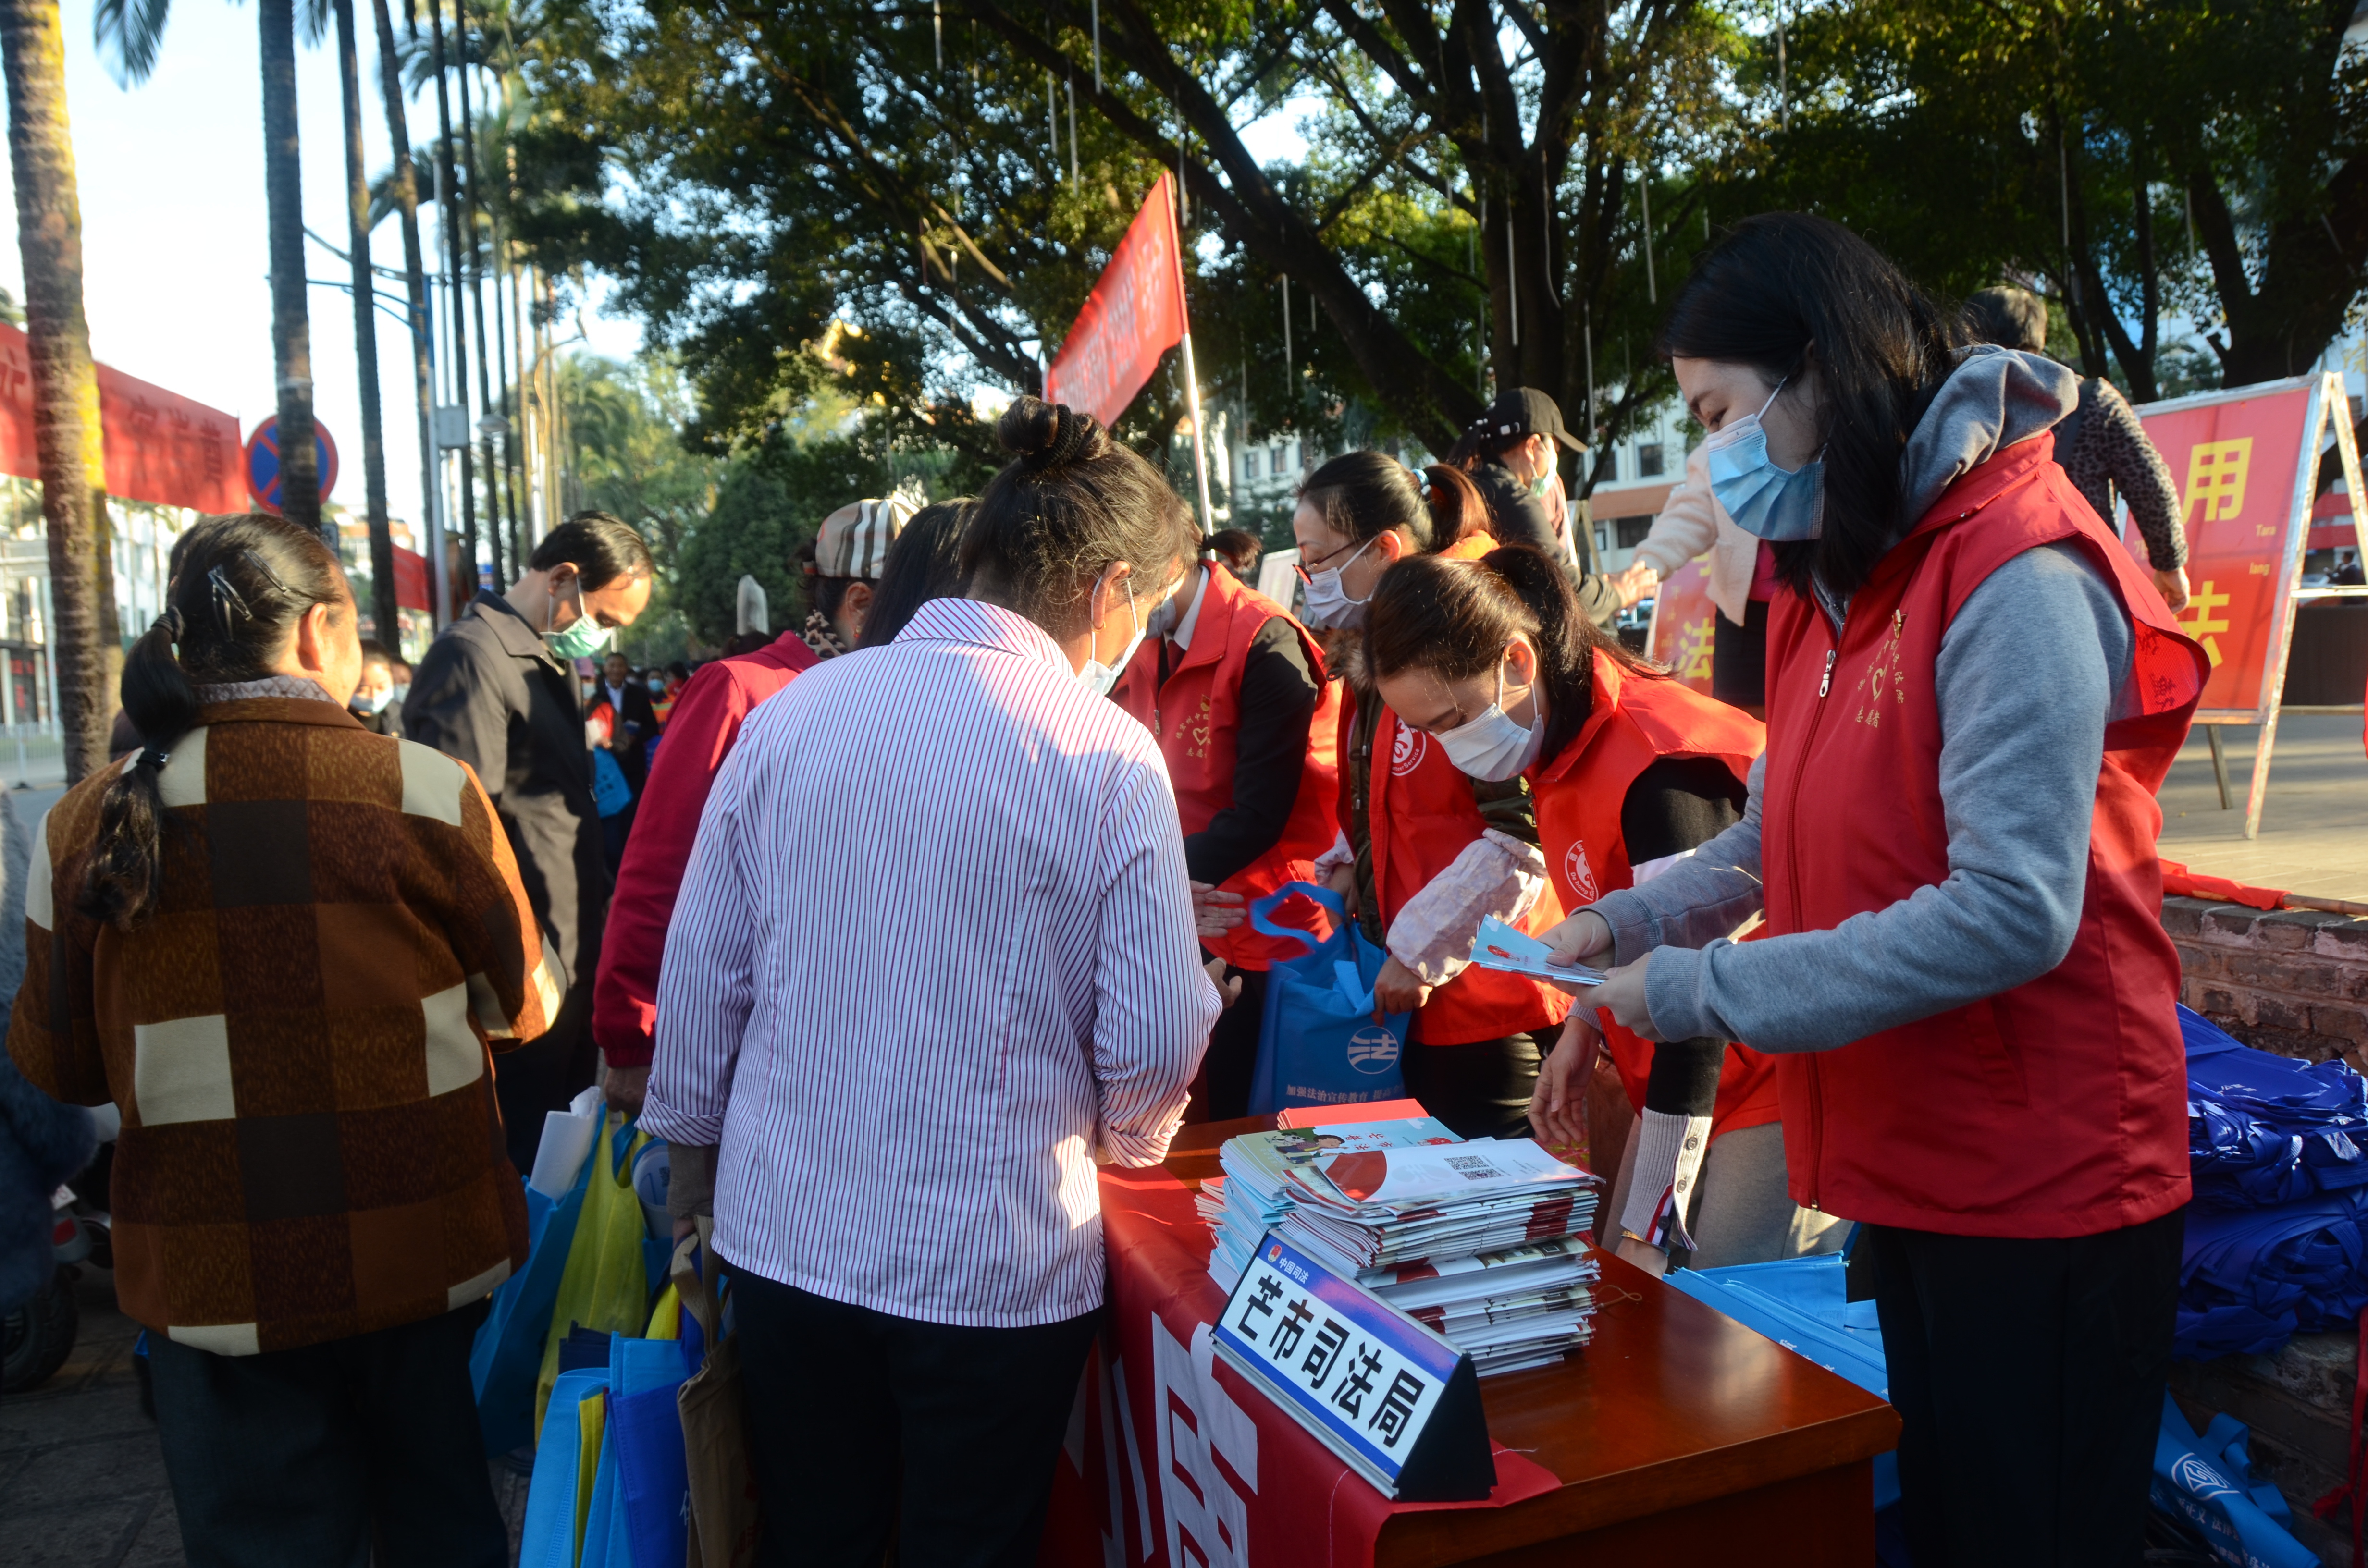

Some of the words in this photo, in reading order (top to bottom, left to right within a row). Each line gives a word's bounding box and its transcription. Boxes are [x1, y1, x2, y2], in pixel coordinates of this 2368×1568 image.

[1186, 747, 1207, 758] 志愿
[1404, 748, 1420, 769] Service
[1570, 871, 1577, 881] De
[1286, 1084, 1369, 1103] 加强法治宣传教育
[1279, 1257, 1309, 1284] 中国司法
[1237, 1274, 1426, 1448] 芒市司法局
